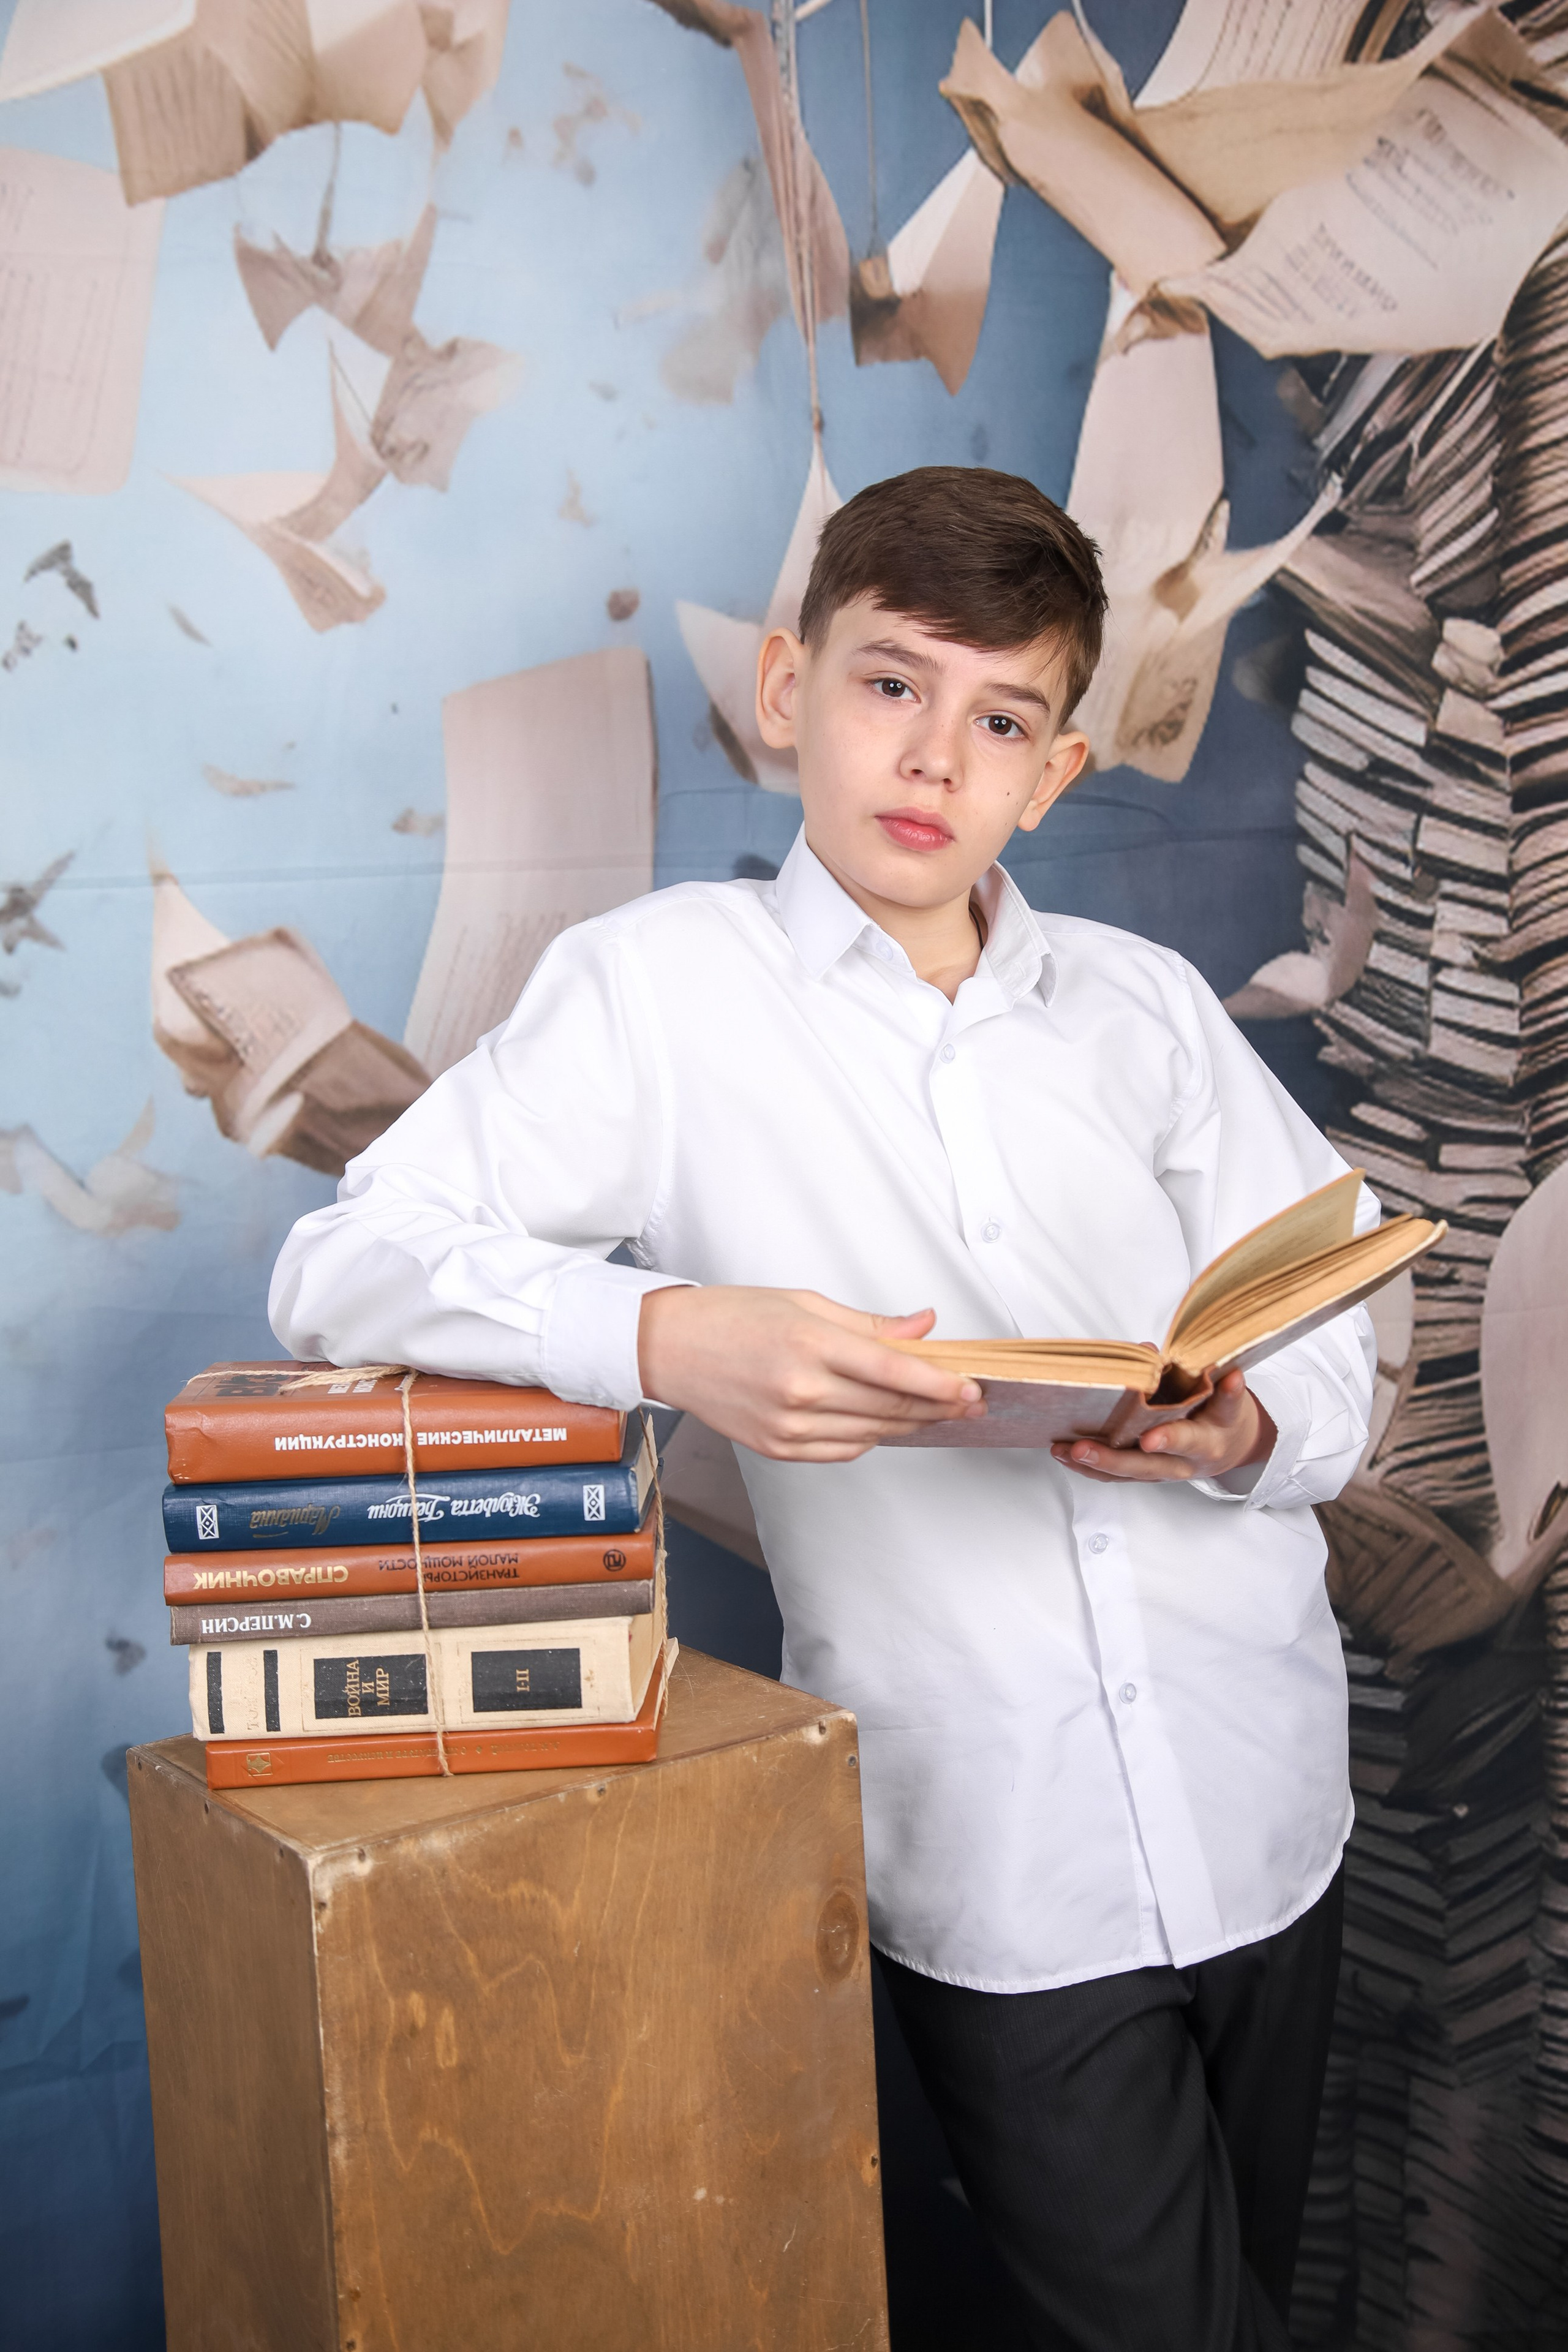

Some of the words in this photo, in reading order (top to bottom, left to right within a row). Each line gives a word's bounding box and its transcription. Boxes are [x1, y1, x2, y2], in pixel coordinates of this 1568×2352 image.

[274, 1433, 404, 1450] КОНСТРУКЦИИ
[417, 1428, 567, 1446] МЕТАЛЛИЧЕСКИЕ
[450, 1491, 541, 1518] Жюльетта
[249, 1502, 341, 1538] Марианна
[467, 1553, 519, 1570] МАЛОЙ
[192, 1565, 349, 1589] СПРАВОЧНИК
[422, 1568, 520, 1583] ТРАНЗИСТОРЫ
[345, 1659, 361, 1716] ВОЙНА
[361, 1681, 374, 1694] И
[375, 1667, 390, 1706] МИР
